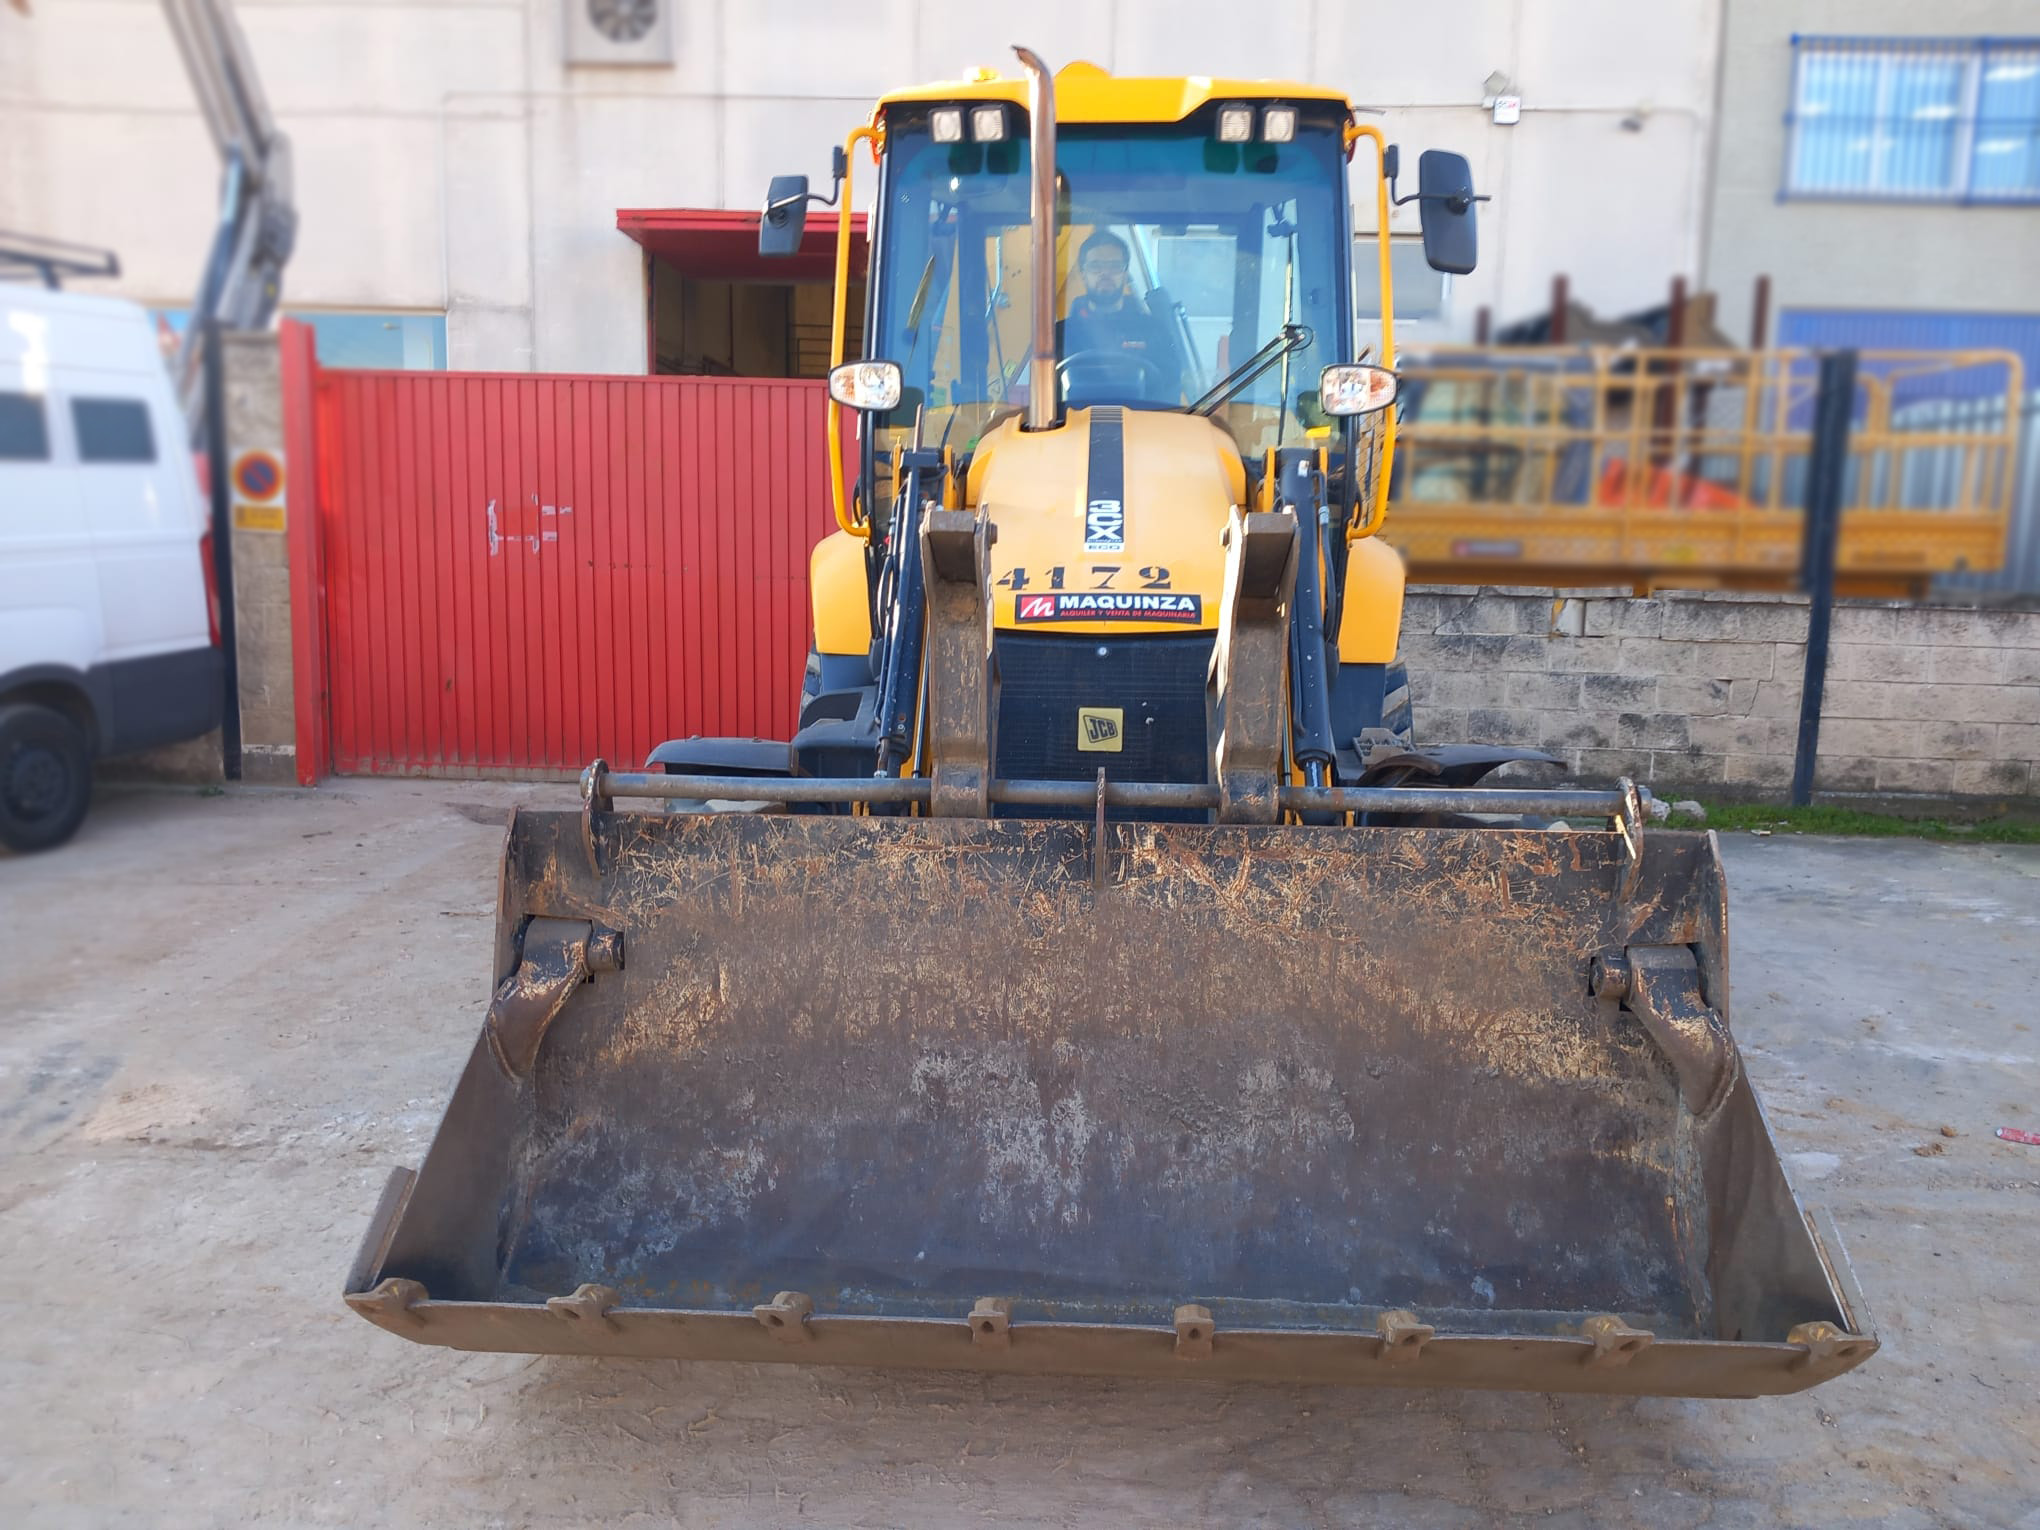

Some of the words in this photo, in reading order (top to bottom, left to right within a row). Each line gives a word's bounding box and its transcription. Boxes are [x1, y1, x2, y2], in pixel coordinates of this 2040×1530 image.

[1087, 499, 1123, 540] 3CX
[996, 566, 1171, 591] 4172
[1060, 595, 1196, 611] MAQUINZA
[1060, 609, 1097, 617] ALQUILER
[1105, 609, 1130, 617] VENTA
[1132, 609, 1142, 617] DE
[1143, 610, 1197, 619] MAQUINARIA
[1089, 718, 1116, 740] JCB
